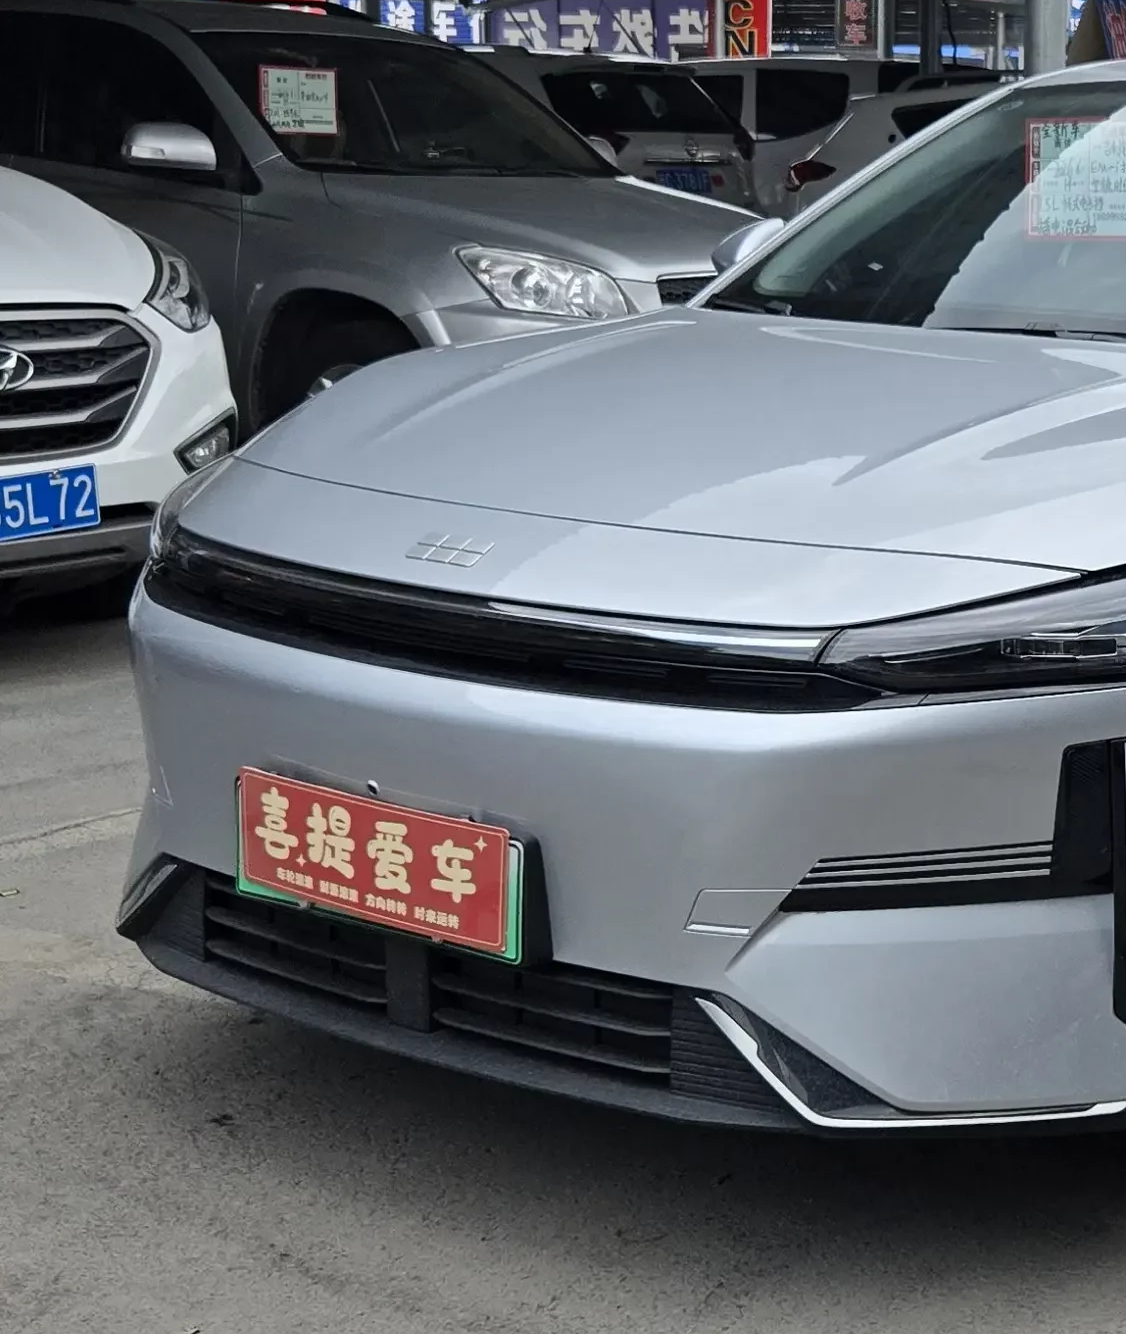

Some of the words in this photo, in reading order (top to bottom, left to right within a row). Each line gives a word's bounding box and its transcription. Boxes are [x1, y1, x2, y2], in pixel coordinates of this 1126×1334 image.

[0, 473, 95, 529] 5L72
[255, 787, 477, 903] 喜提爱车
[414, 906, 460, 930] 时来运转
